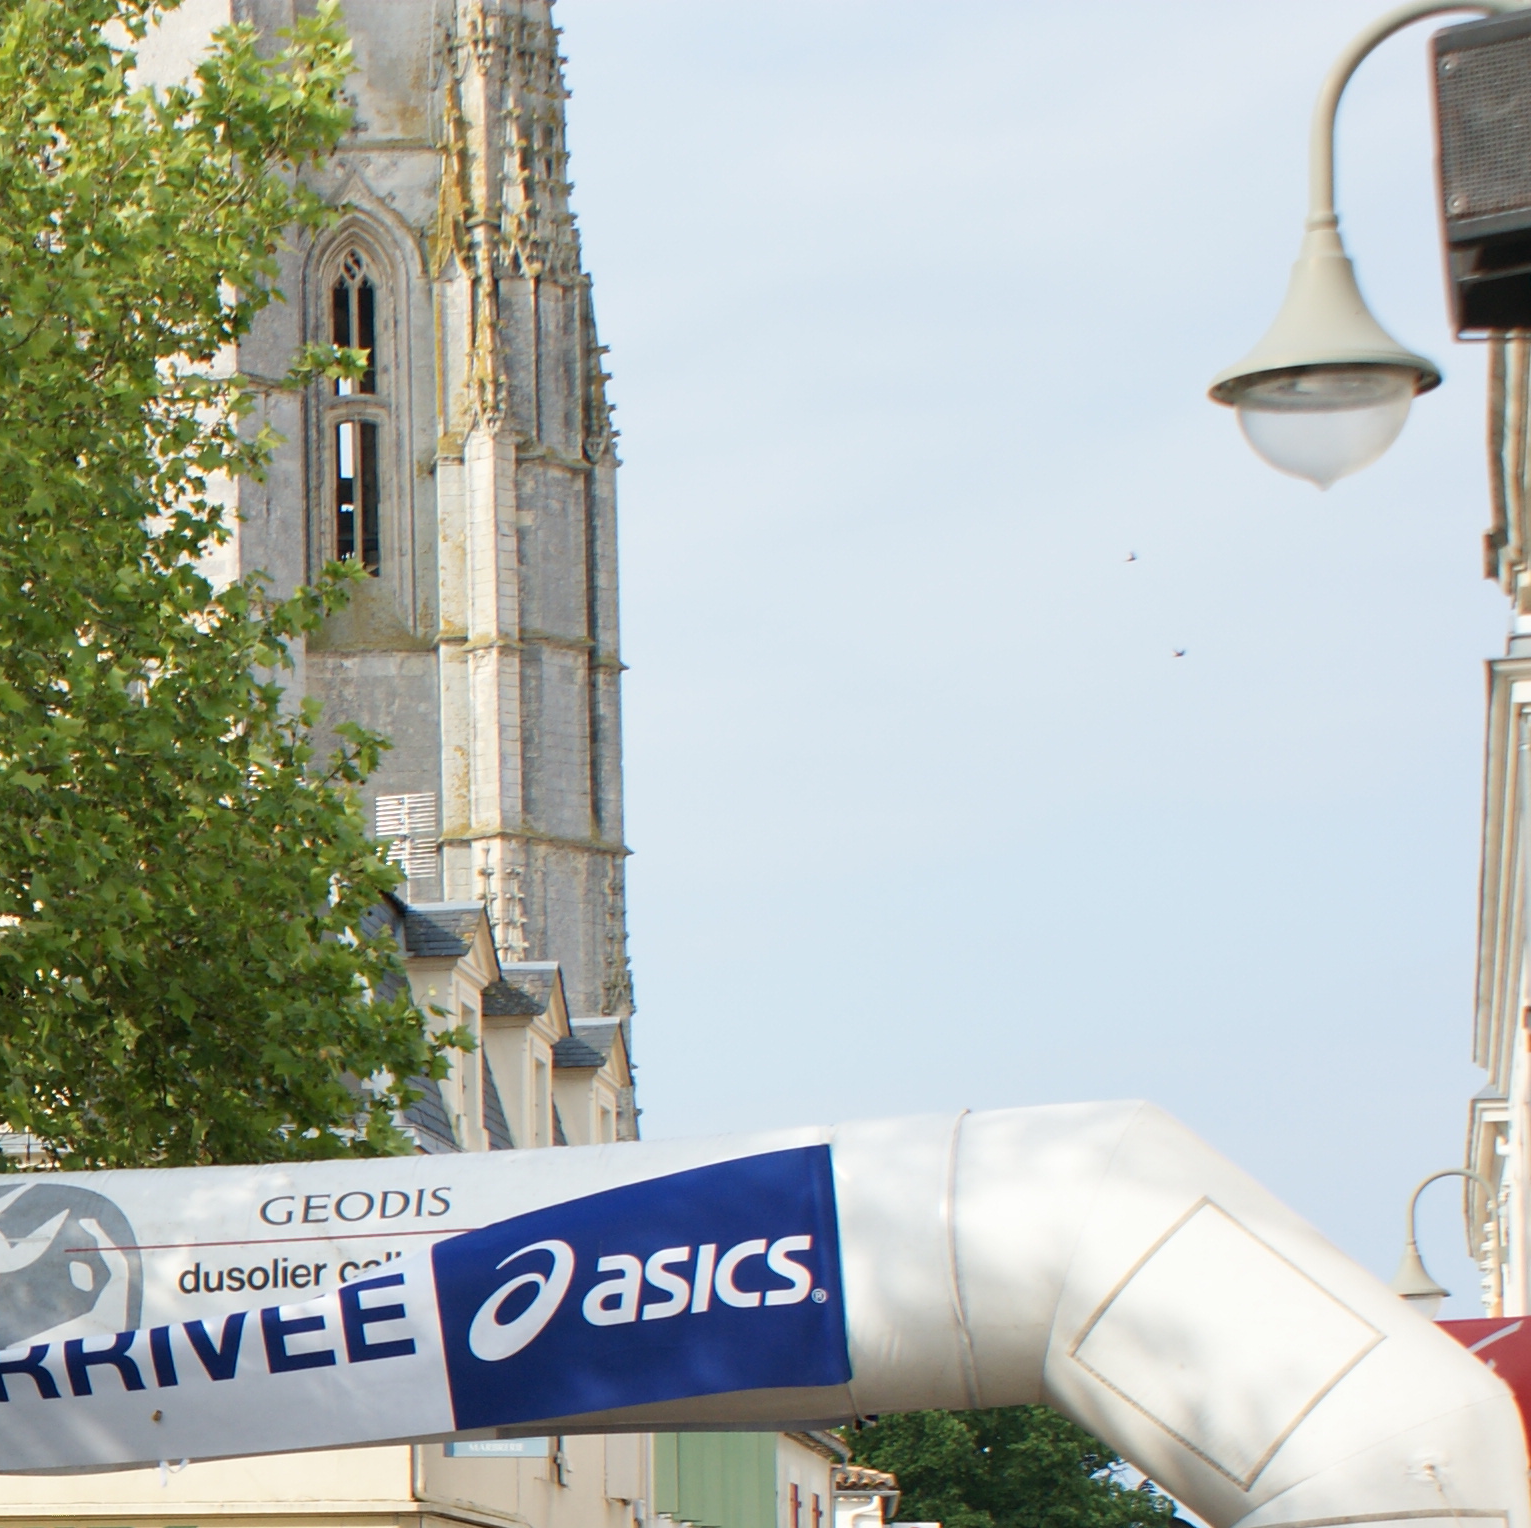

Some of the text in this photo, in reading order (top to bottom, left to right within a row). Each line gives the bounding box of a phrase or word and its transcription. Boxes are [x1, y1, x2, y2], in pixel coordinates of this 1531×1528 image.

[259, 1186, 452, 1227] GEODIS
[179, 1256, 328, 1294] dusolier
[582, 1235, 814, 1328] asics
